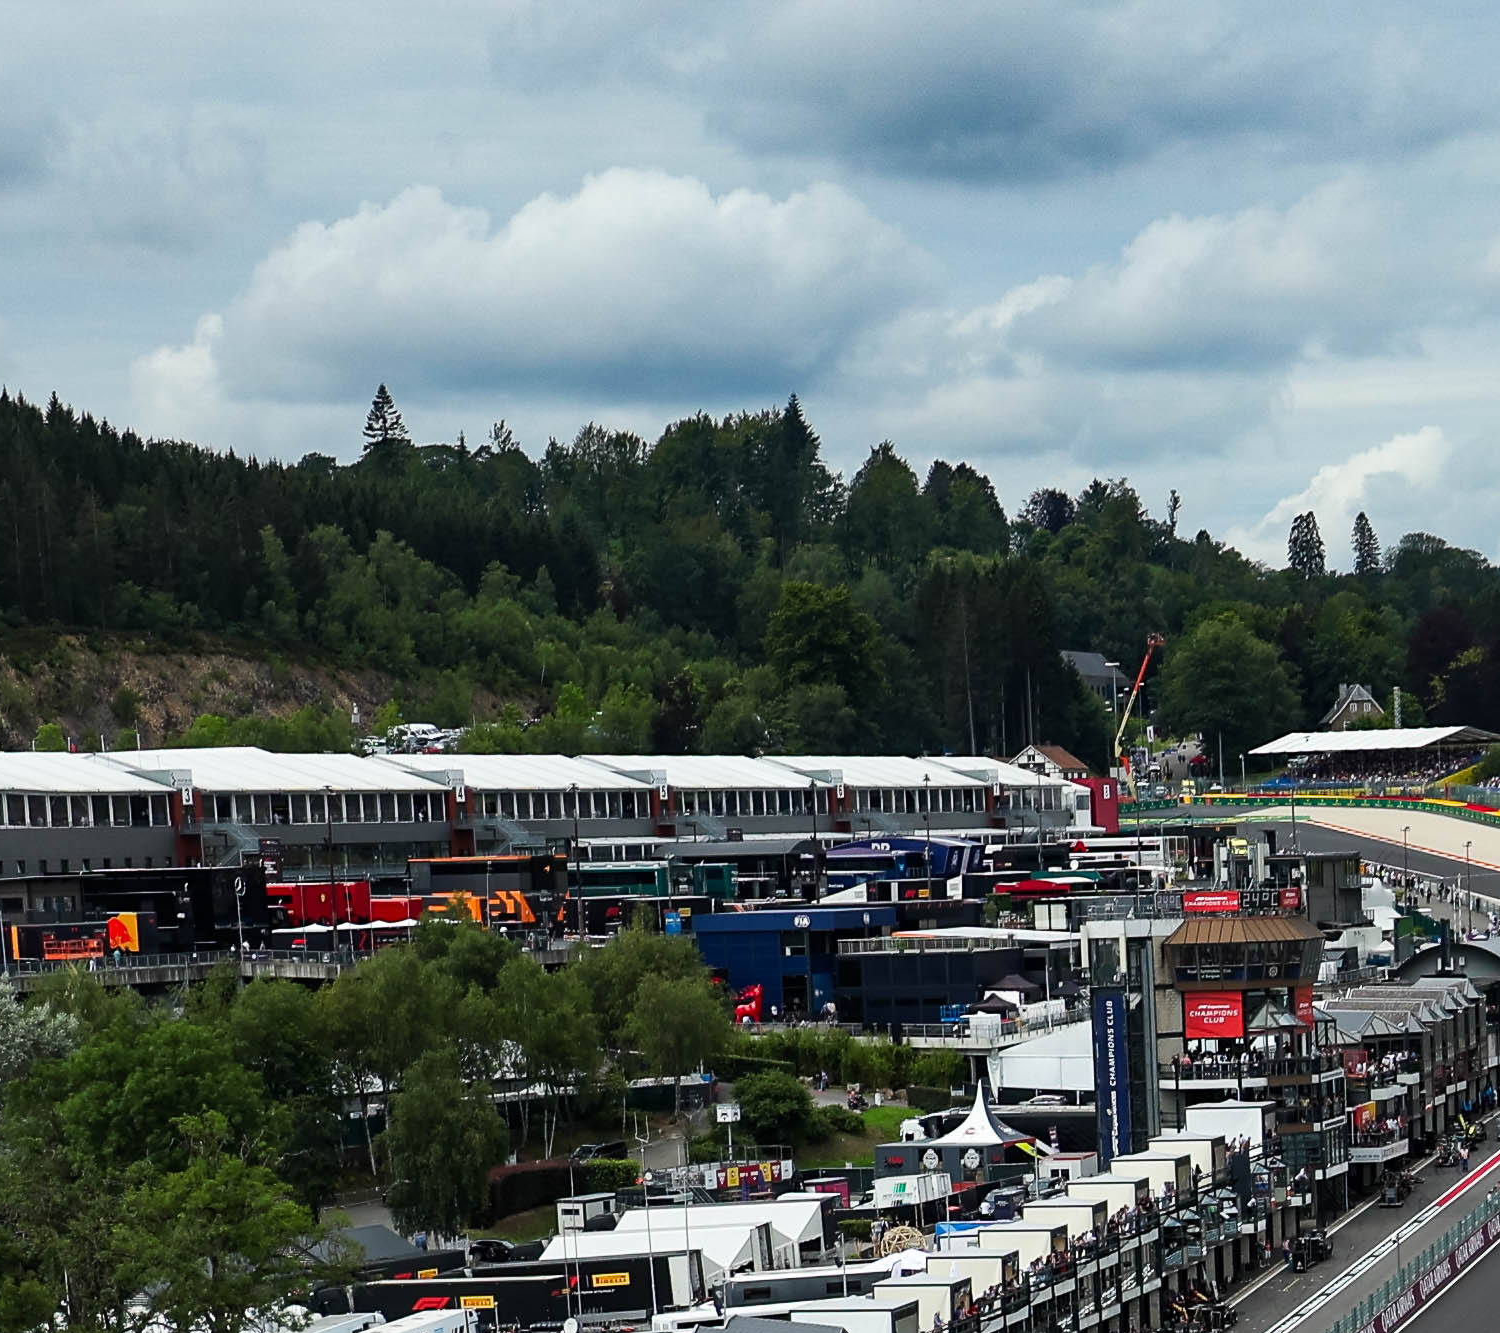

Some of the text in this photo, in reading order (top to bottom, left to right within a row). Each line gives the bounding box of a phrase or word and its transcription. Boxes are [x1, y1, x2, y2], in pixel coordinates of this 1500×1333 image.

[1106, 1000, 1114, 1026] CLUB
[1189, 1009, 1238, 1017] CHAMPIONS
[1107, 1027, 1117, 1087] CHAMPIONS
[594, 1275, 629, 1285] PIRELLI
[463, 1297, 494, 1307] PIRELLI
